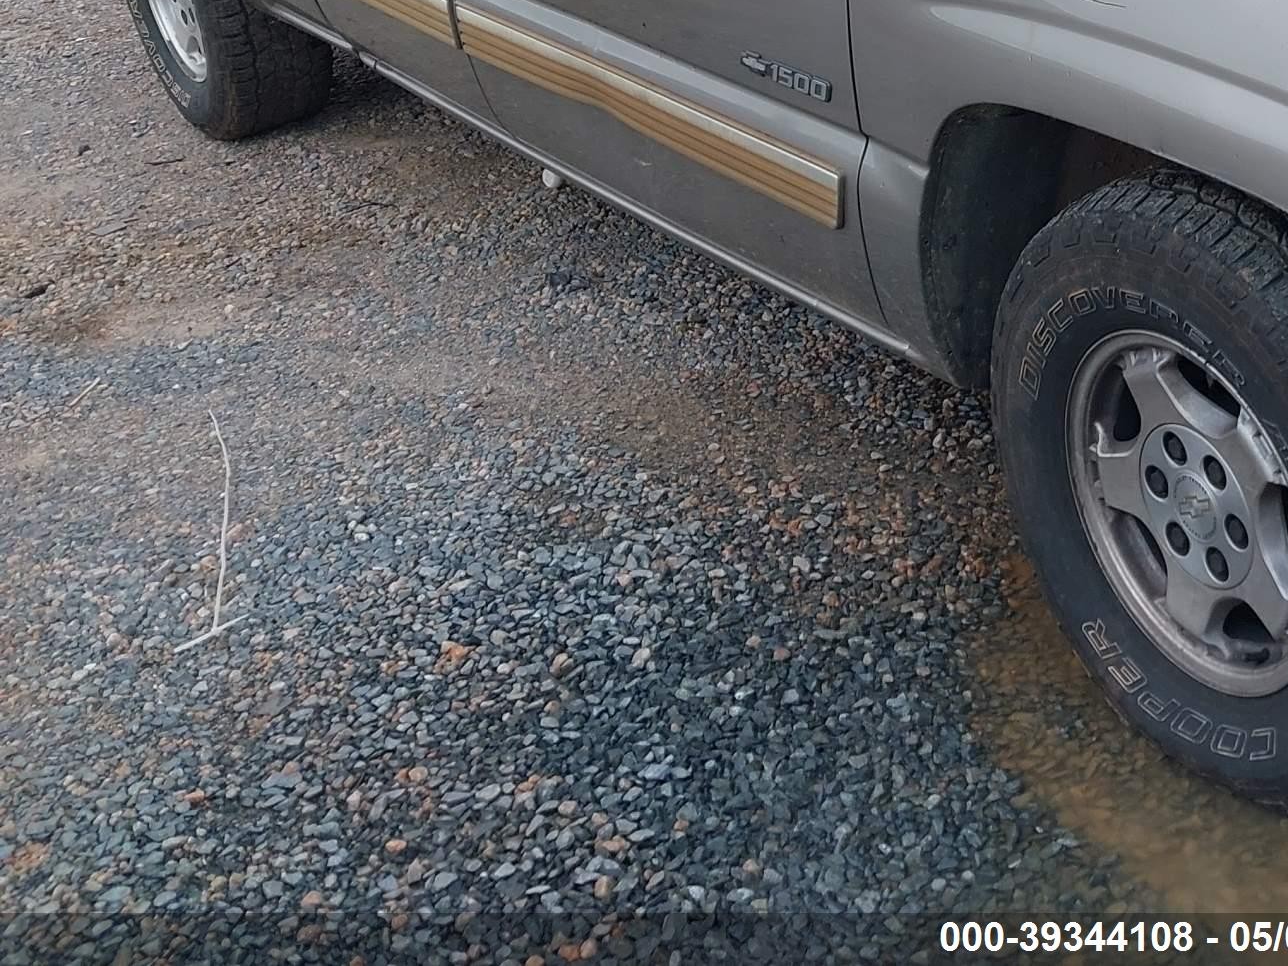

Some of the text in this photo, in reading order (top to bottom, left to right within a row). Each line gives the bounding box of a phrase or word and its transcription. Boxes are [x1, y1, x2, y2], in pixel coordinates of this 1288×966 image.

[769, 63, 830, 102] 1500
[1018, 285, 1245, 401] DISCOVERER
[1081, 618, 1277, 761] COOPER
